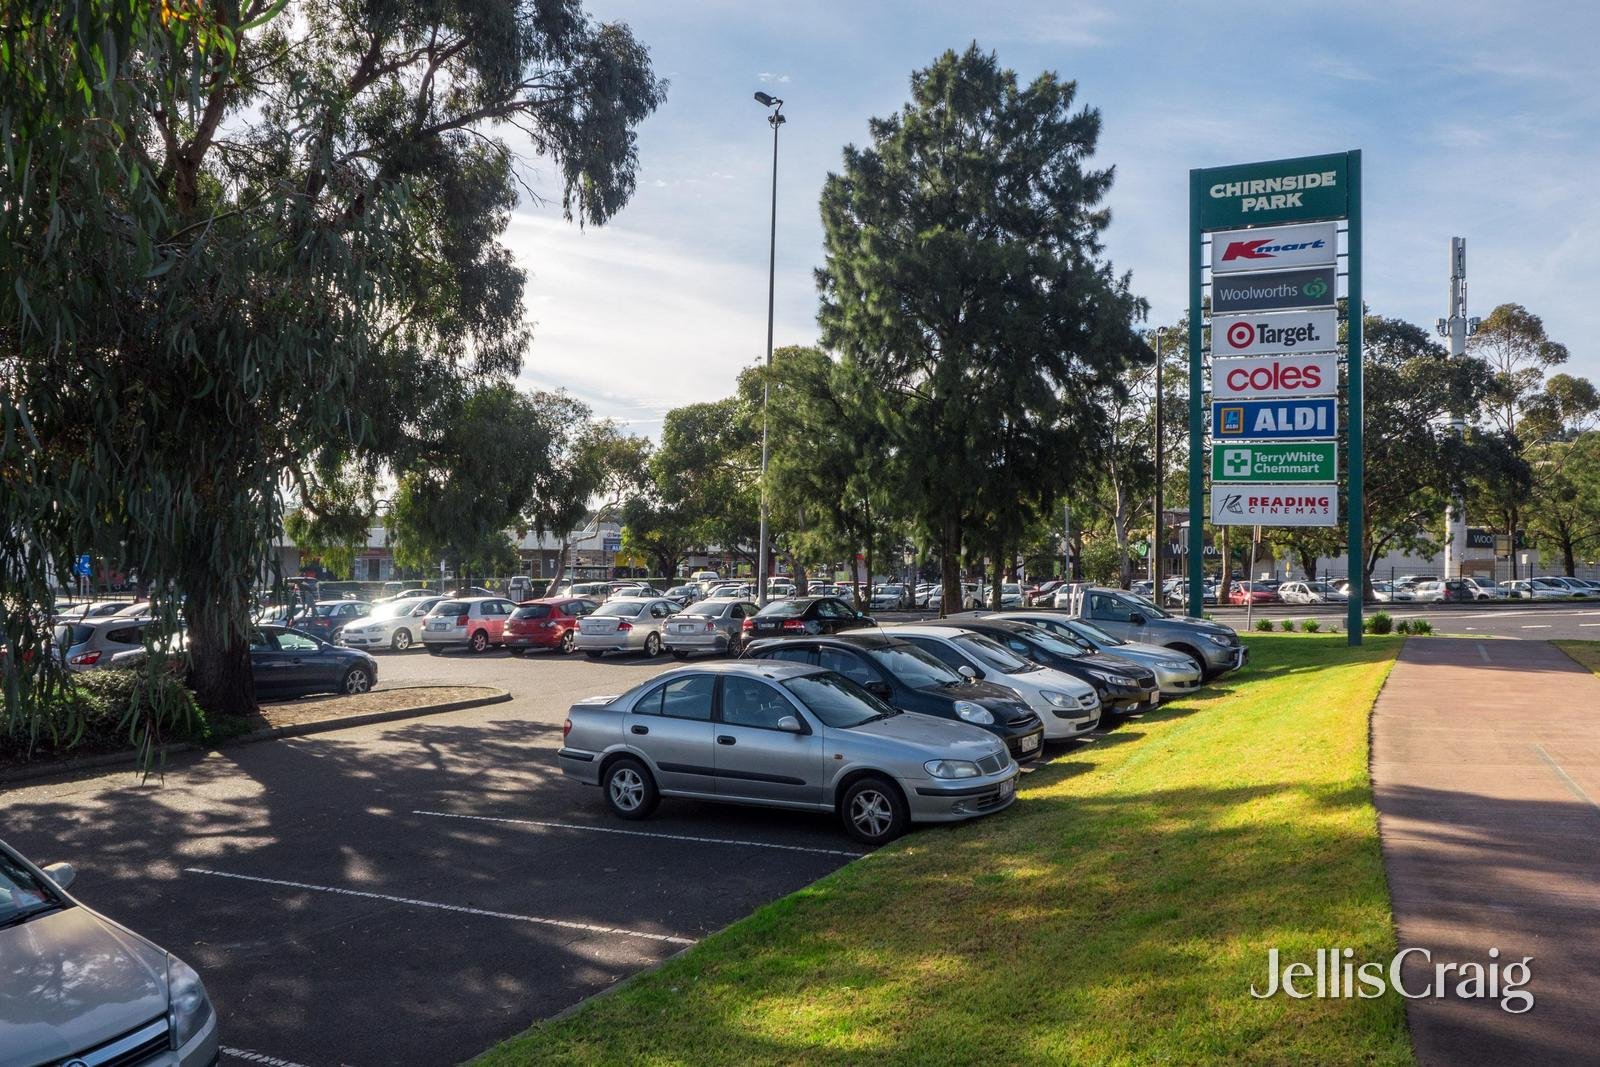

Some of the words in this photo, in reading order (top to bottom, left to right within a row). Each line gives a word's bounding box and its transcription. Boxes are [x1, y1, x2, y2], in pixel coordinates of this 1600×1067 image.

[1210, 170, 1337, 199] CHIRNSIDE
[1242, 193, 1303, 212] PARK
[1221, 238, 1326, 262] Kmart
[1219, 284, 1298, 301] Woolworths
[1226, 362, 1321, 392] coles
[1253, 406, 1328, 432] ALDI
[1253, 452, 1325, 465] TerryWhite
[1253, 463, 1320, 474] Chemmart
[1248, 496, 1330, 507] READING
[1248, 507, 1330, 515] CINEMAS
